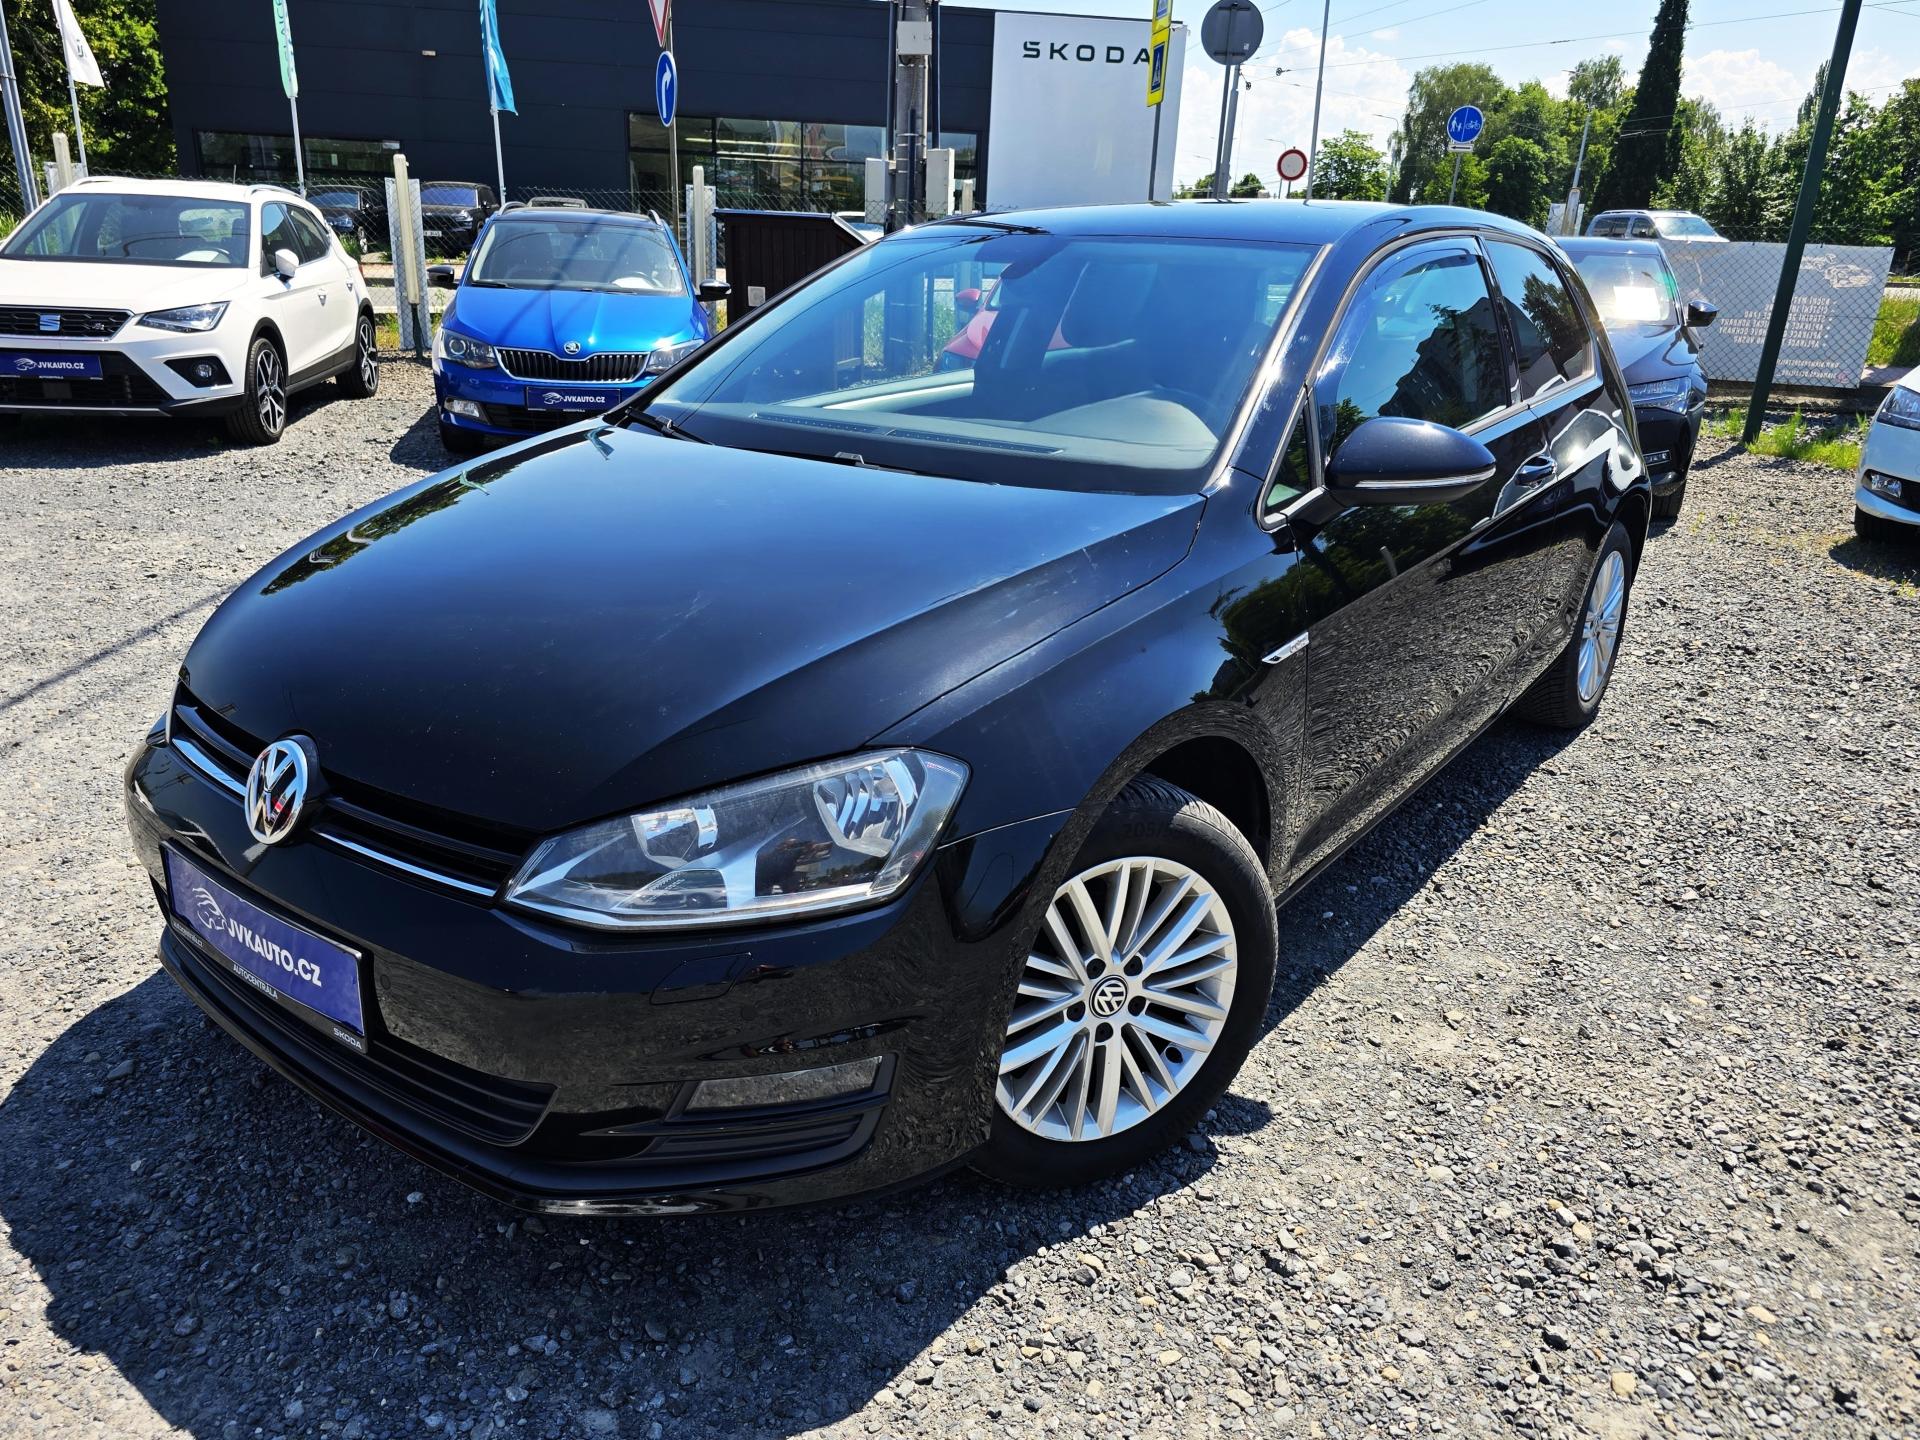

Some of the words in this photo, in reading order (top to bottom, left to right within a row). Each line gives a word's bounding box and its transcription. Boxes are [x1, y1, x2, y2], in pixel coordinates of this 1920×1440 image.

[38, 361, 85, 370] JVKAUTO.CZ
[563, 395, 606, 403] JVKAUTO.CZ
[228, 918, 322, 987] JVKAUTO.CZ
